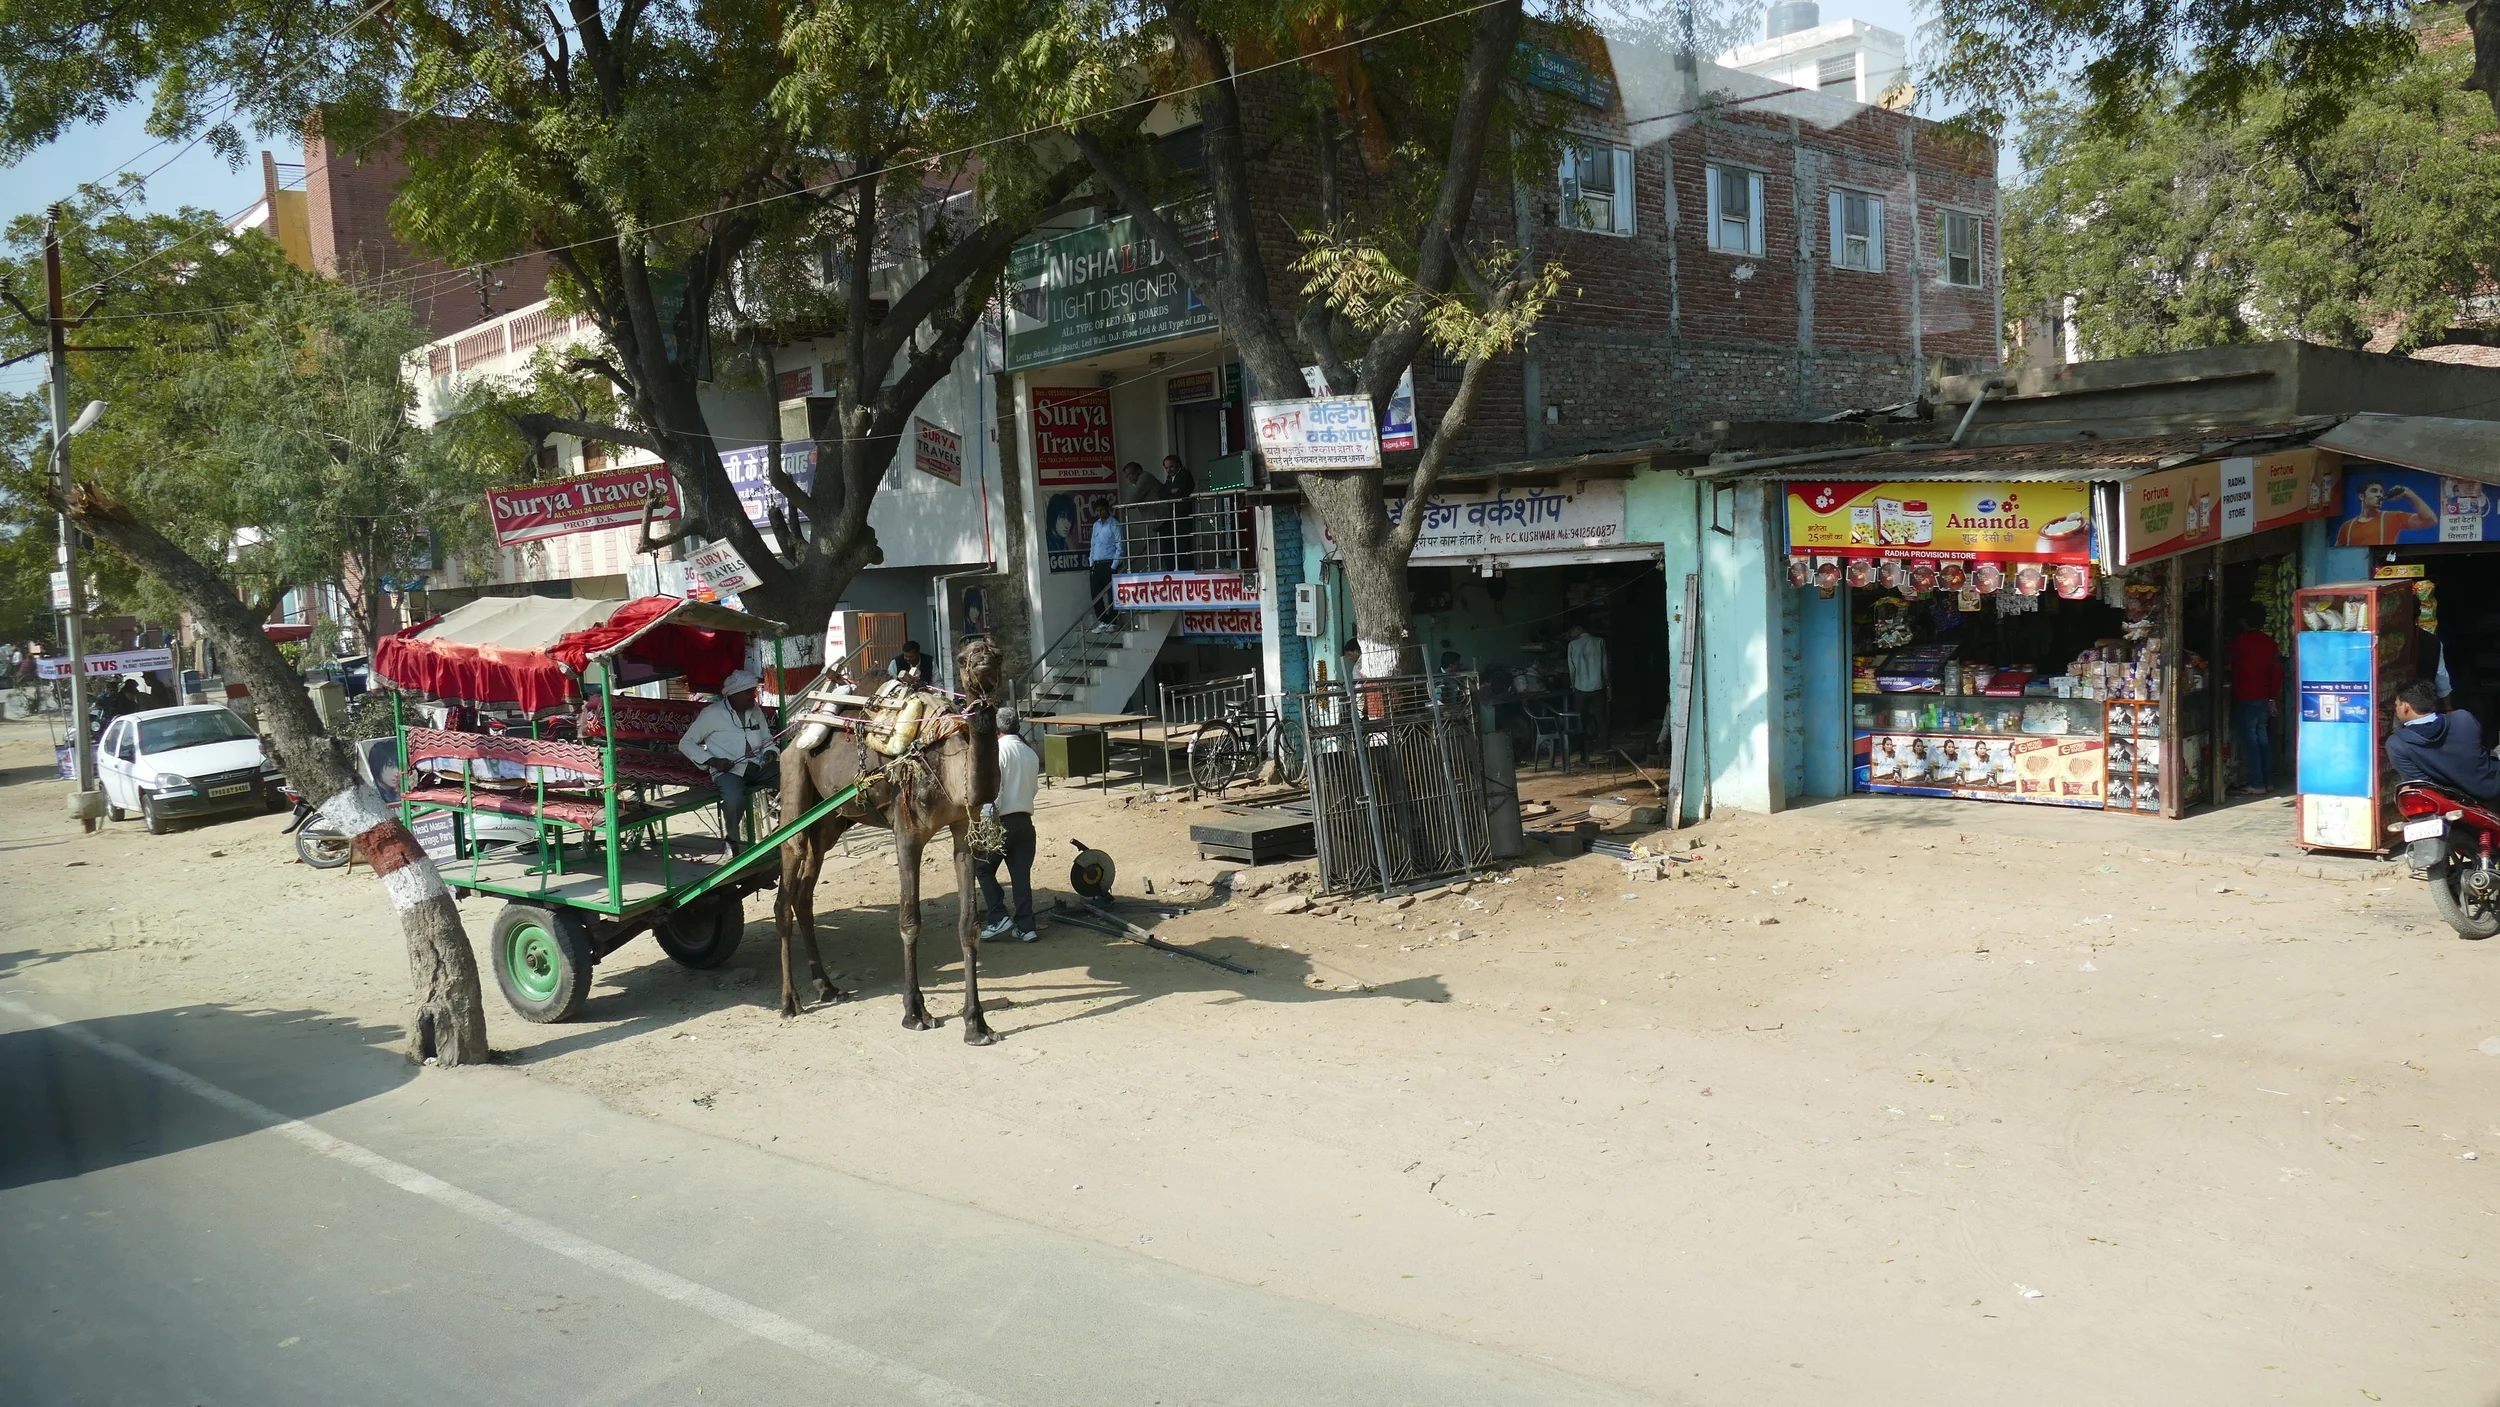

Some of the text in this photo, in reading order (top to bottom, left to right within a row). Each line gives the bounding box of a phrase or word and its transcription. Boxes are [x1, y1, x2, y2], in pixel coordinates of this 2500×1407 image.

[1050, 248, 1119, 291] NISHA
[1121, 239, 1165, 273] LED
[1053, 291, 1096, 323] LIGHT
[1101, 272, 1178, 311] DESIGNER
[1061, 305, 1169, 338] ALL TYPE OF LED AND BOARDS
[1122, 329, 1138, 340] Floor
[1139, 325, 1150, 335] Led
[1158, 322, 1167, 331] All
[1168, 319, 1184, 330] Type
[1185, 317, 1192, 326] of
[1193, 314, 1207, 324] LED
[1038, 399, 1108, 433] Surya
[1261, 410, 1301, 440] करन
[922, 427, 956, 451] SURYA
[1038, 430, 1111, 454] Travels
[917, 439, 961, 466] TRAVELS
[2270, 464, 2294, 477] Fortune
[2228, 476, 2246, 488] RADHA
[495, 472, 669, 519] Surya Travels
[2143, 486, 2170, 502] Fortune
[2223, 490, 2252, 505] PROVISION
[554, 511, 567, 519] ALL
[568, 509, 584, 518] TAXI
[584, 507, 593, 515] 24
[593, 504, 618, 514] HOURS,
[1466, 487, 1566, 527] वर्कशॉप
[2228, 507, 2246, 520] STORE
[563, 515, 618, 530] PROP. D.K.
[1946, 513, 2030, 529] Ananda
[2461, 524, 2475, 532] पानी
[1439, 535, 1457, 546] काम
[1459, 531, 1475, 546] होता
[1519, 530, 1556, 542] KUSHWAH
[1808, 533, 1820, 543] 25
[1983, 532, 2000, 543] देसी
[2003, 532, 2014, 543] घी
[2448, 532, 2468, 540] मिलता
[696, 549, 732, 569] SURYA
[1050, 554, 1079, 570] GENTS
[1885, 549, 1977, 560] RADHA PROVISION STORE
[684, 566, 695, 581] 3G
[701, 560, 746, 582] TRAVELS
[1117, 574, 1211, 604] करन स्टील एण्ड
[1184, 611, 1216, 632] करन
[1217, 609, 1253, 632] स्टील
[55, 663, 89, 675] TAA
[91, 660, 118, 672] TVS
[413, 823, 428, 835] Head
[416, 834, 440, 847] arriage
